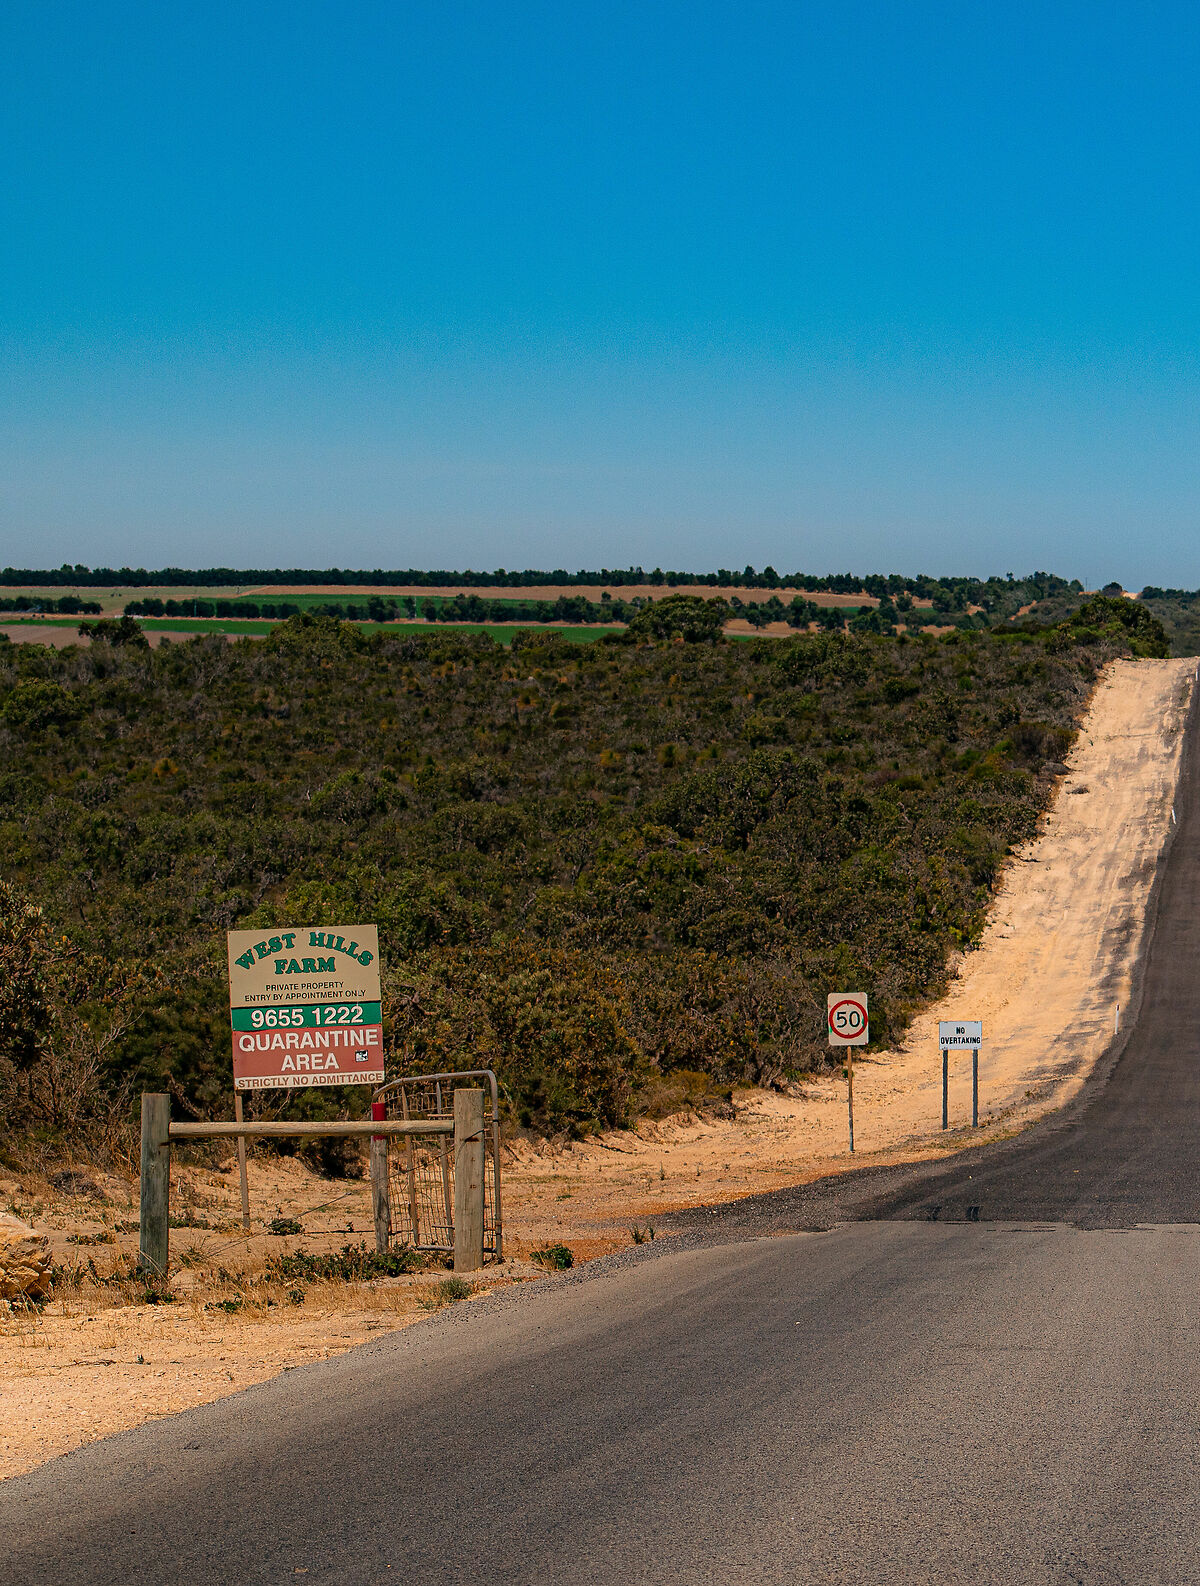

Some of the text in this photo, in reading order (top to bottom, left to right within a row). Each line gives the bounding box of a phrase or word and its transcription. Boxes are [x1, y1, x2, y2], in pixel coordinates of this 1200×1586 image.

[234, 931, 374, 970] WEST HILLS
[274, 956, 337, 975] FARM
[244, 989, 366, 1002] ENTRY BY APPOINTMENT ONLY
[265, 981, 344, 992] PRIVATE PROPERTY
[251, 1005, 364, 1028] 9655 1222
[836, 1010, 861, 1028] 50
[955, 1026, 966, 1035] NO
[238, 1029, 379, 1052] QUARANTINE
[940, 1036, 981, 1045] OVERTAKING
[281, 1052, 340, 1072] AREA
[238, 1072, 383, 1088] STRICTLY NO ADMITTANCE
